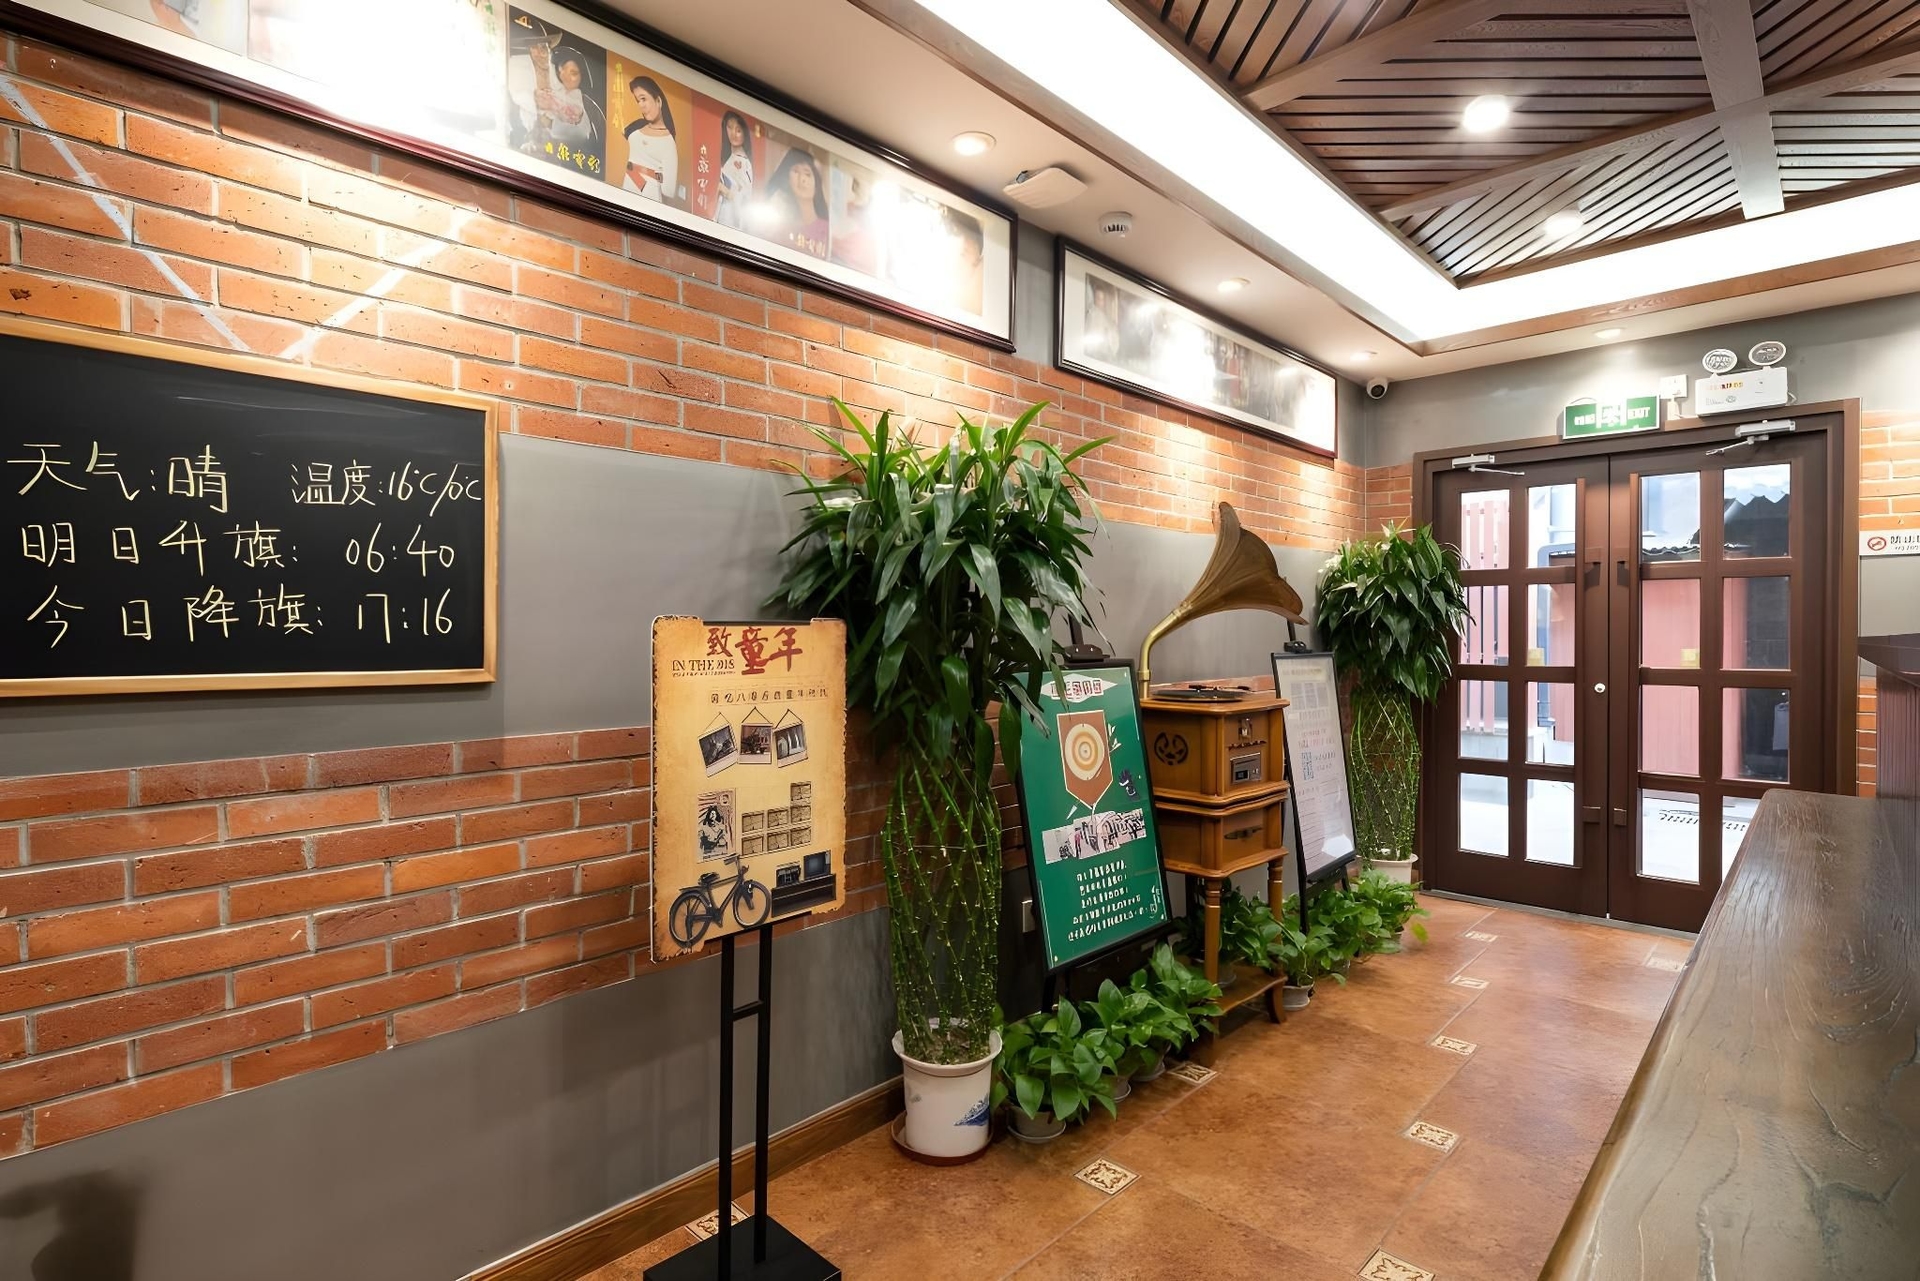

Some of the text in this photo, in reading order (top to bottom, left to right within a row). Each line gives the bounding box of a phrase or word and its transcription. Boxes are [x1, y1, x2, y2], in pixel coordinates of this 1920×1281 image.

[346, 523, 455, 577] 06:40
[358, 588, 453, 644] 17:16
[706, 627, 803, 675] 致童年
